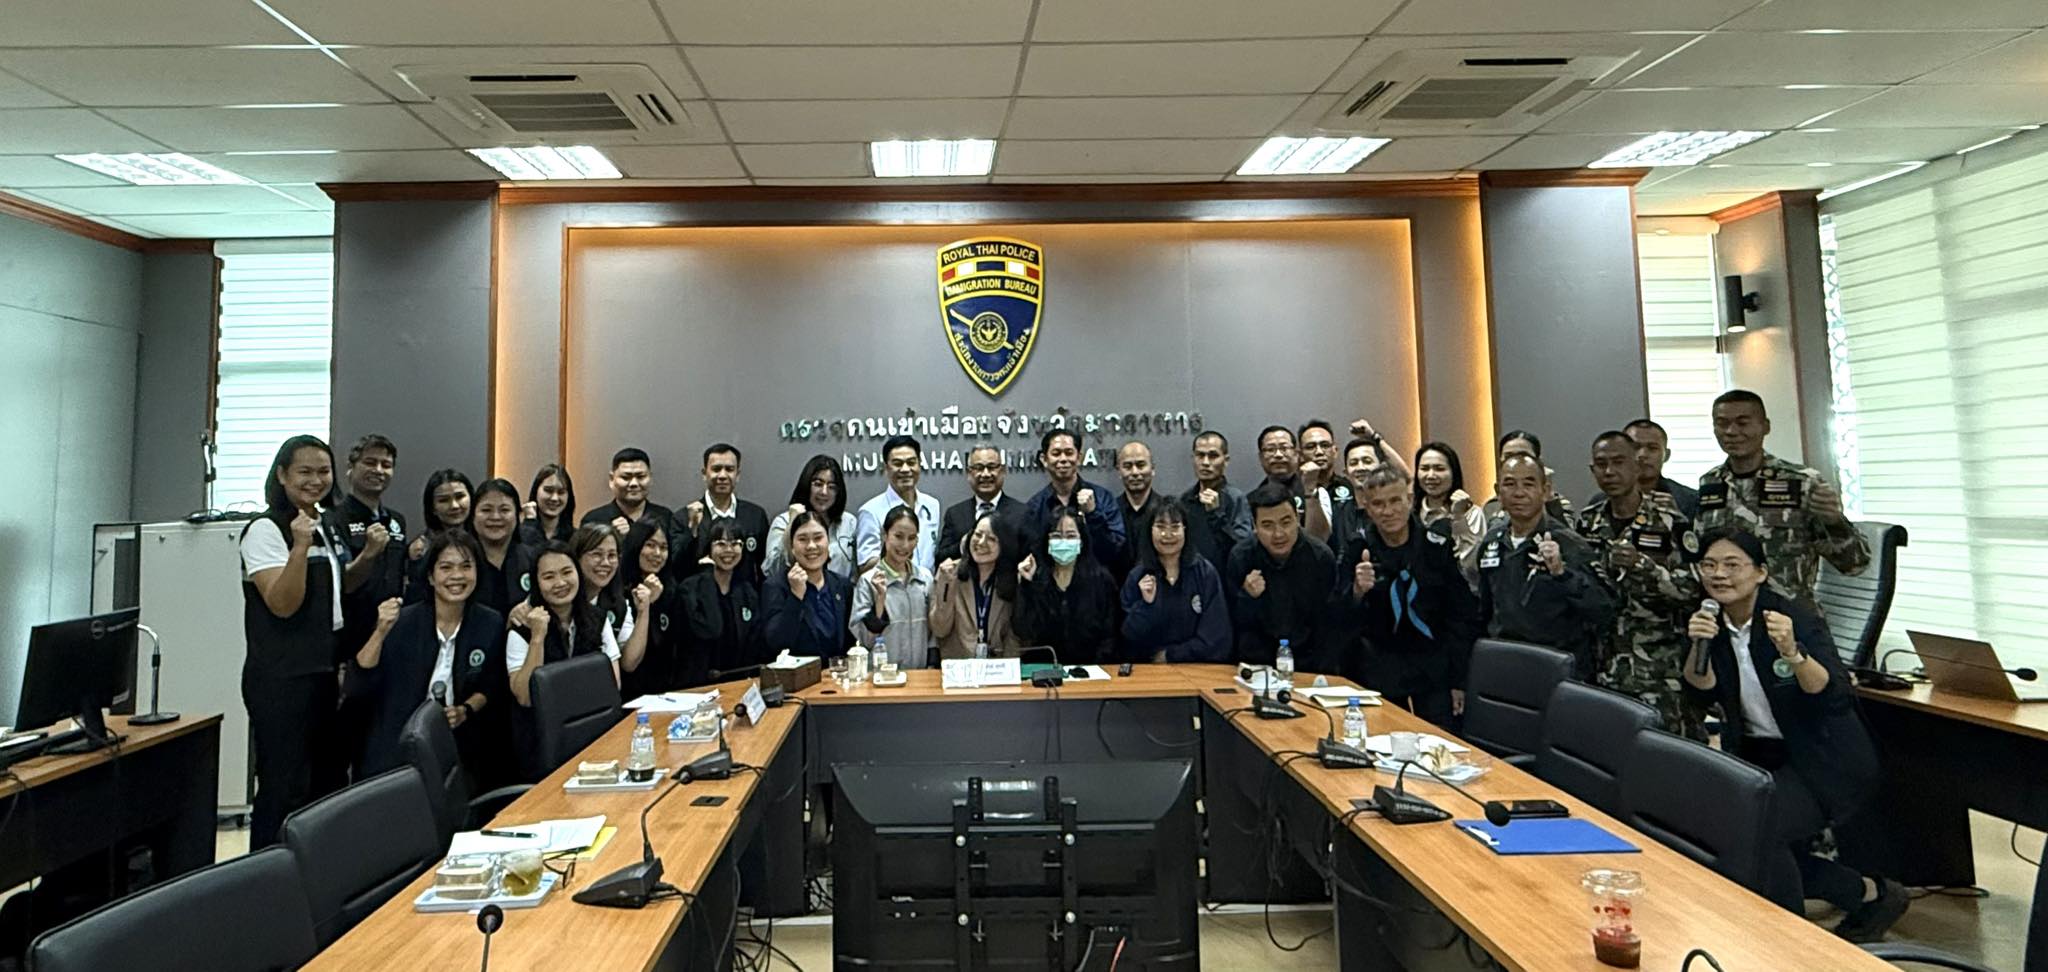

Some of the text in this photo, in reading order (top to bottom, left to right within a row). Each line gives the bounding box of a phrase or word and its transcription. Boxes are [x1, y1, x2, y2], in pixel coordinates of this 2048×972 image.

[943, 244, 1036, 264] ROYAL THAI POLICE
[945, 279, 1037, 296] IMMIGRATION BUREAU
